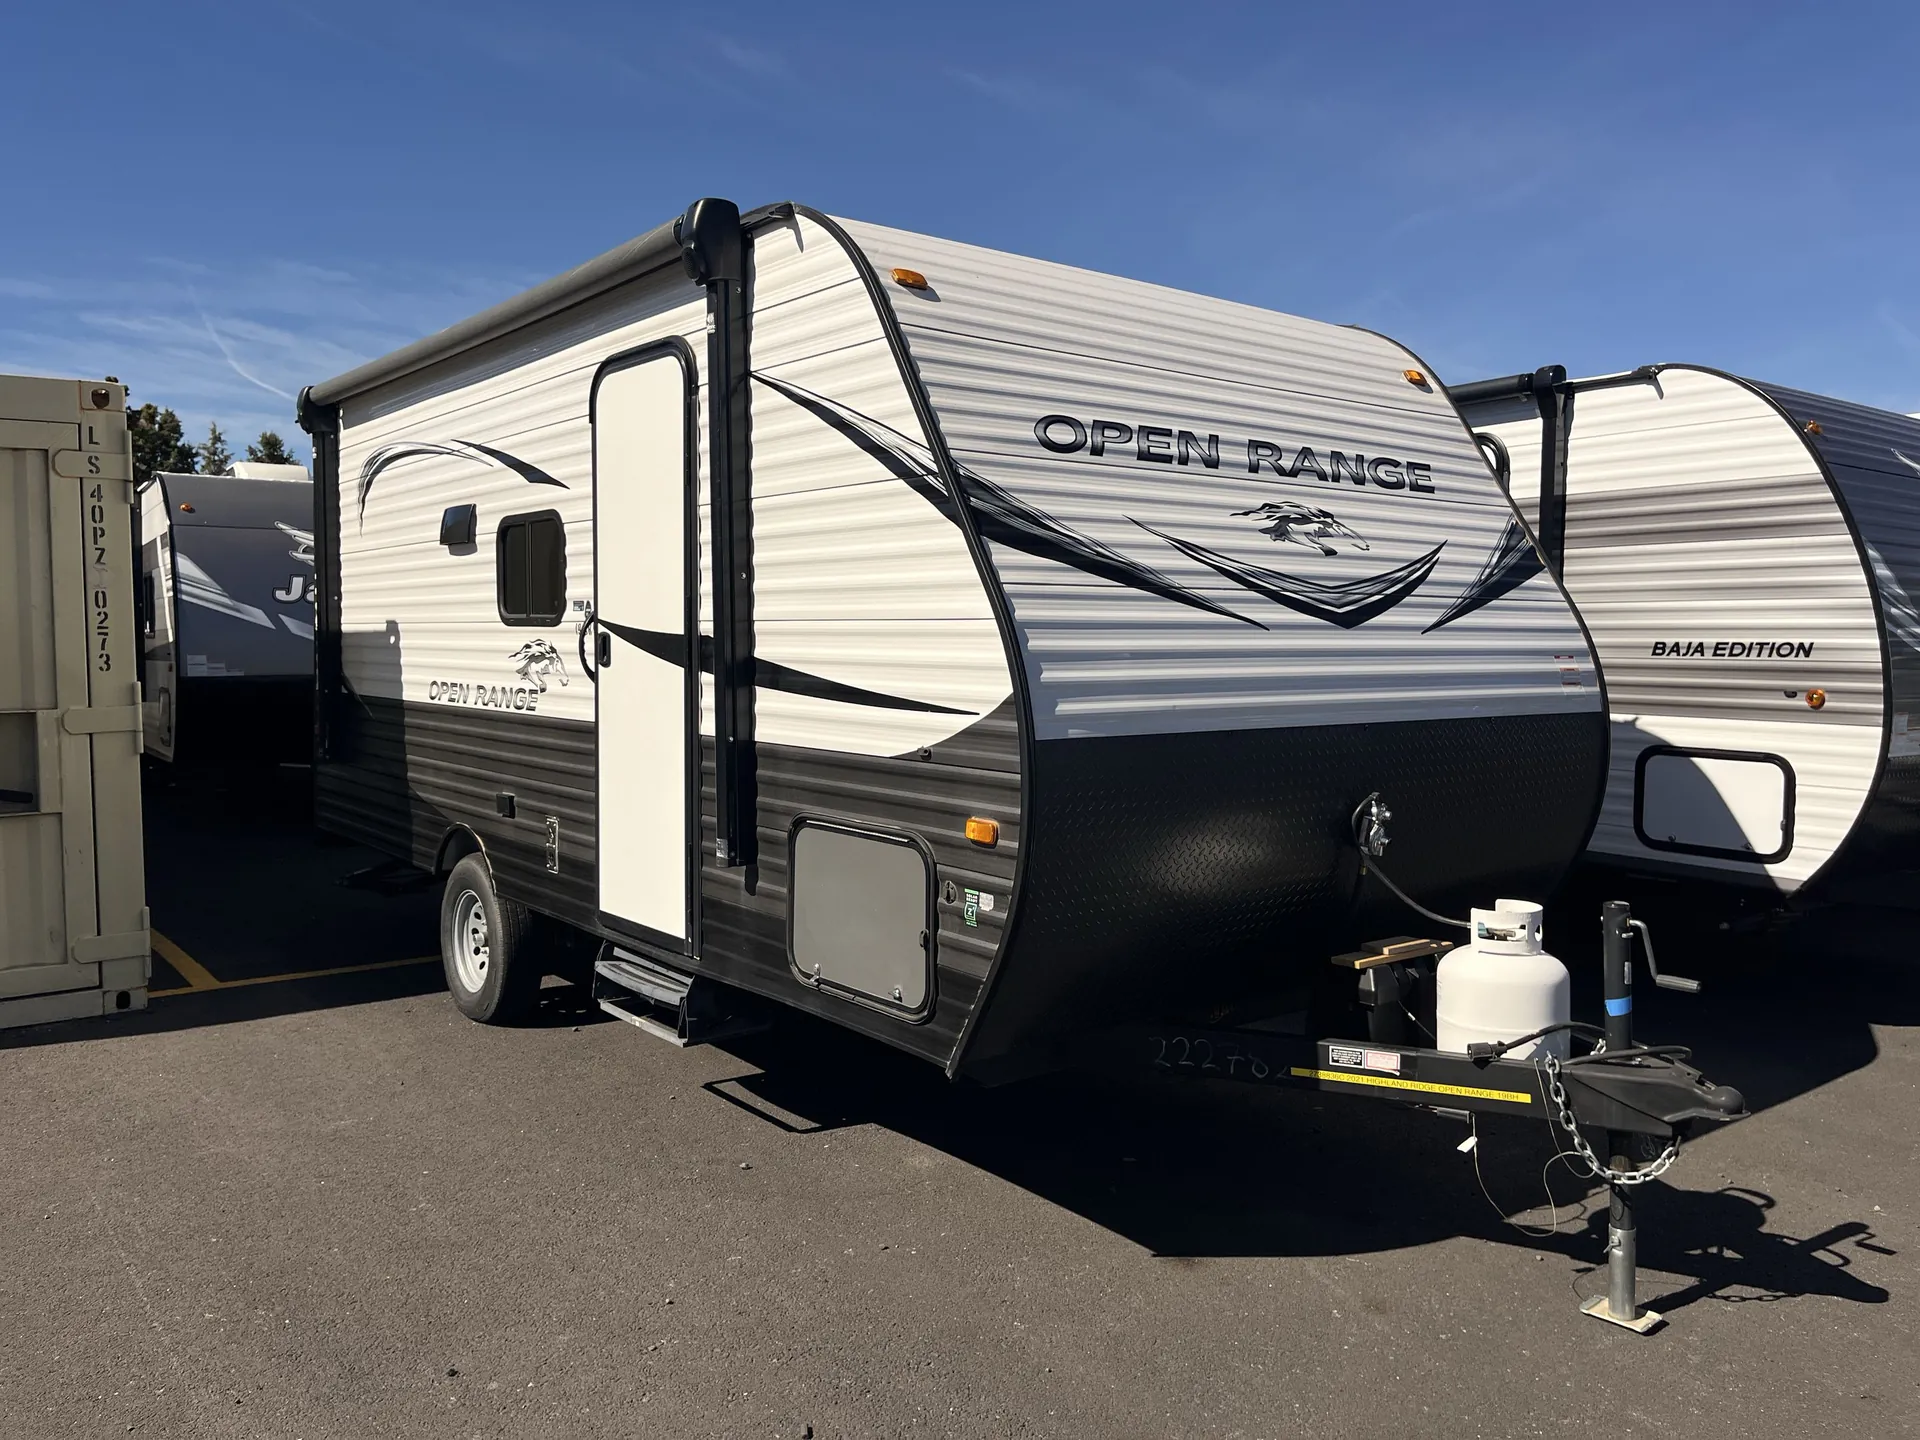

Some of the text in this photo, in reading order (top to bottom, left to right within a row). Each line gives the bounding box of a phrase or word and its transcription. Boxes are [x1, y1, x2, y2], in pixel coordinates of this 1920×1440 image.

[1033, 414, 1435, 494] OPEN RANGE
[1651, 641, 1814, 658] BAJA EDITION
[428, 680, 539, 711] OPEN RANGE
[1346, 1074, 1365, 1084] 2021
[1366, 1077, 1409, 1089] HIGHLAND
[1410, 1082, 1436, 1092] RIDGE
[1438, 1085, 1463, 1095] OPEN
[1464, 1088, 1495, 1099] RANGE
[1497, 1091, 1519, 1101] 19BH
